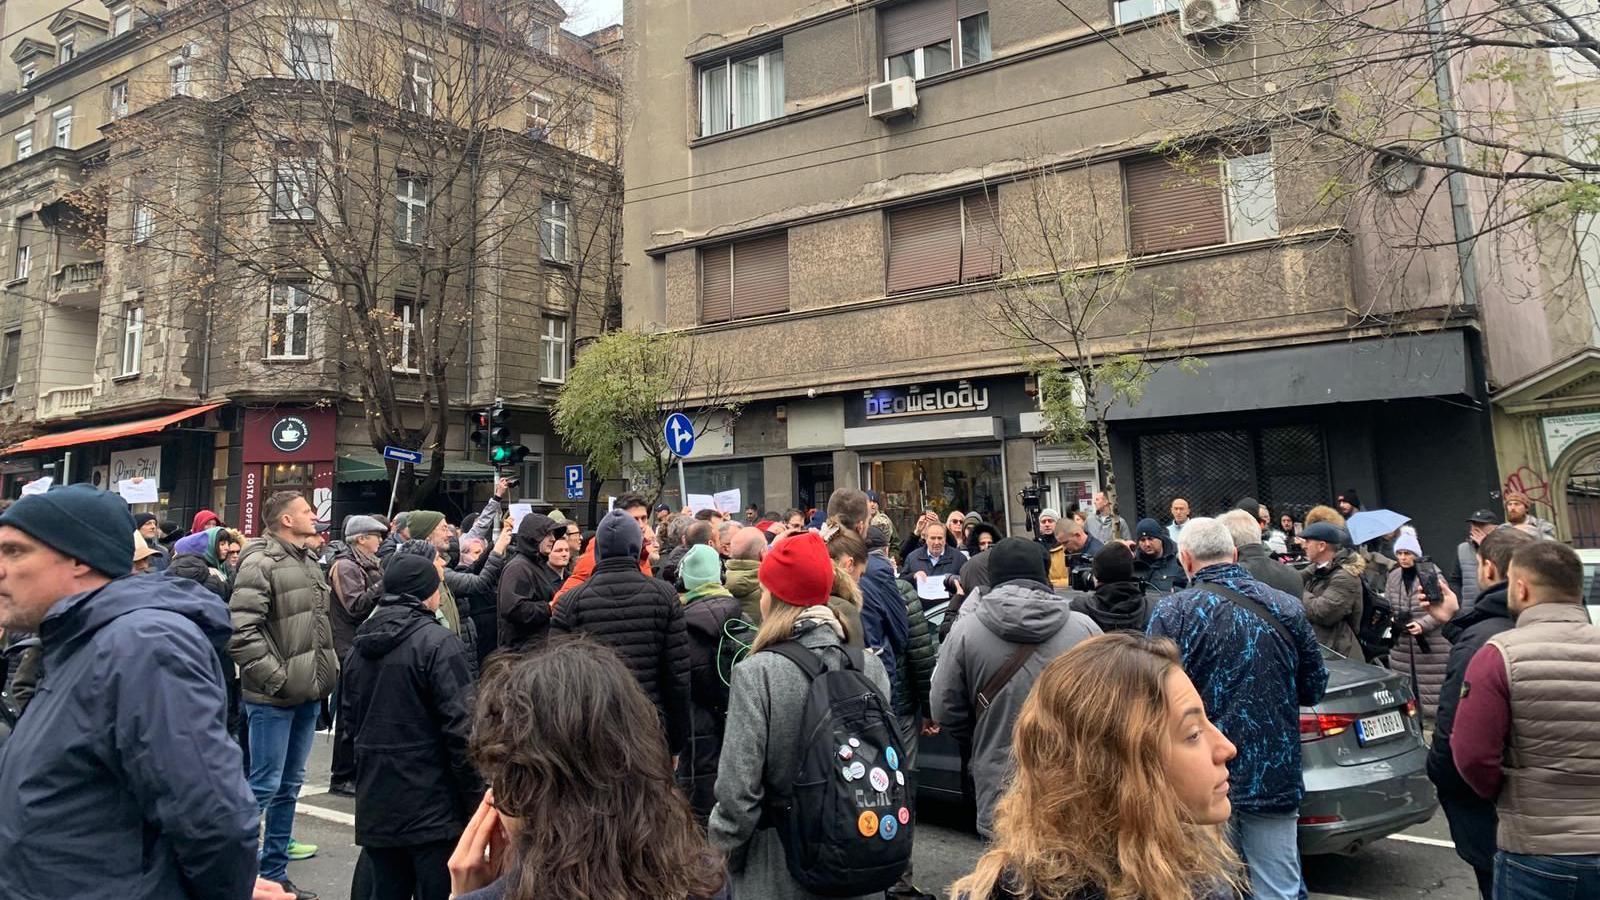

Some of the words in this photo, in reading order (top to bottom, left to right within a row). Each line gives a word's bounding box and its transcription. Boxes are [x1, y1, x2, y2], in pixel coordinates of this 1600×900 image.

[246, 473, 255, 500] COSTA
[569, 469, 579, 486] P
[245, 502, 253, 535] COFFEE
